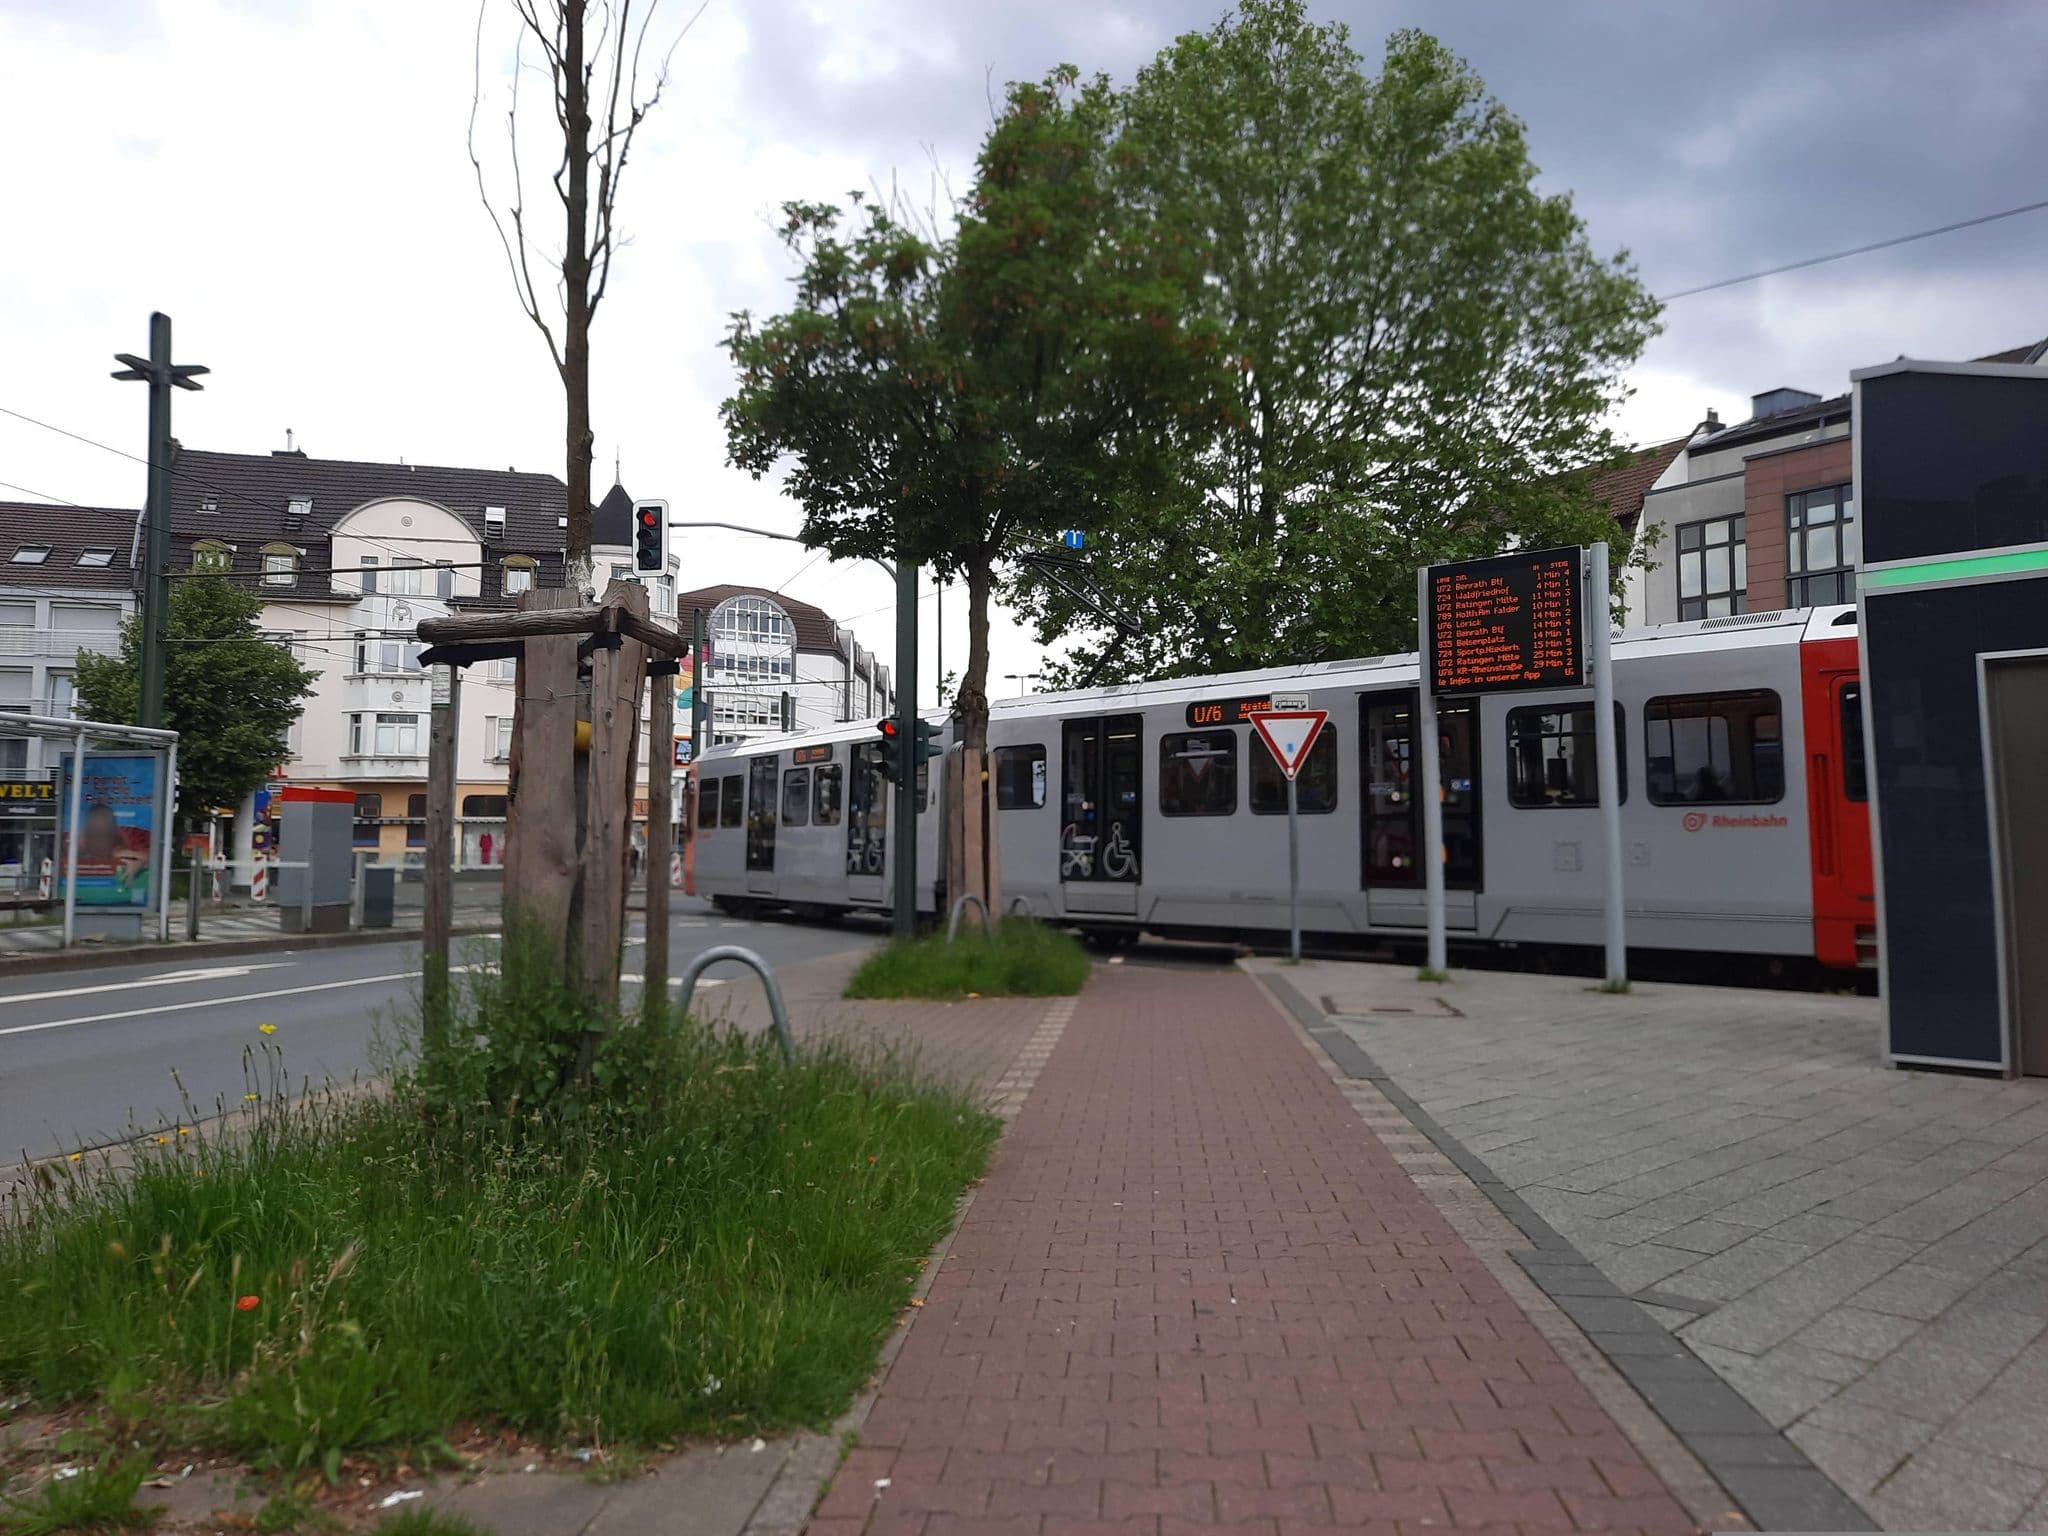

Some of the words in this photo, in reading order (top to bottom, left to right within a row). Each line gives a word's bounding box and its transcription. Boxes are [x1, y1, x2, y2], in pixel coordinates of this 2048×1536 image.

[1437, 585, 1451, 593] U72
[1456, 580, 1487, 590] Benrath
[1537, 572, 1541, 580] 1
[1544, 570, 1561, 579] Min
[1456, 586, 1510, 599] Waldfriedhof
[1536, 582, 1541, 590] 4
[1544, 581, 1561, 589] Min
[1565, 579, 1570, 587] 1
[1437, 603, 1452, 611] U72
[1456, 600, 1493, 610] Ratingen
[1496, 596, 1519, 604] Mitte
[1532, 592, 1541, 600] 11
[1564, 588, 1571, 597] 3
[1532, 601, 1543, 609] 10
[1544, 600, 1561, 608] Min
[1565, 598, 1570, 606] 1
[1438, 622, 1452, 630] U76
[1532, 611, 1543, 620] 14
[1544, 610, 1562, 618] Min
[1564, 608, 1571, 616] 2
[1438, 631, 1452, 639] U72
[1456, 628, 1488, 637] Benrath
[1533, 621, 1543, 629] 14
[1545, 619, 1562, 628] Min
[1564, 618, 1571, 626] 4
[1456, 636, 1505, 646] Belsenplatz
[1533, 631, 1543, 639] 14
[1545, 629, 1562, 638] Min
[1566, 628, 1571, 636] 1
[1533, 640, 1544, 649] 15
[1545, 639, 1563, 648] Min
[1565, 637, 1572, 646] 5
[1438, 659, 1453, 667] U72
[1457, 656, 1494, 665] Ratingen
[1498, 653, 1520, 661] Mitte
[1533, 650, 1544, 659] 25
[1545, 648, 1563, 657] Min
[1566, 647, 1572, 656] 3
[1533, 660, 1545, 669] 29
[1545, 658, 1563, 667] Min
[1566, 657, 1573, 666] 2
[1487, 673, 1520, 681] unserer
[1523, 671, 1541, 680] App
[1712, 815, 1788, 827] Rheinbahn
